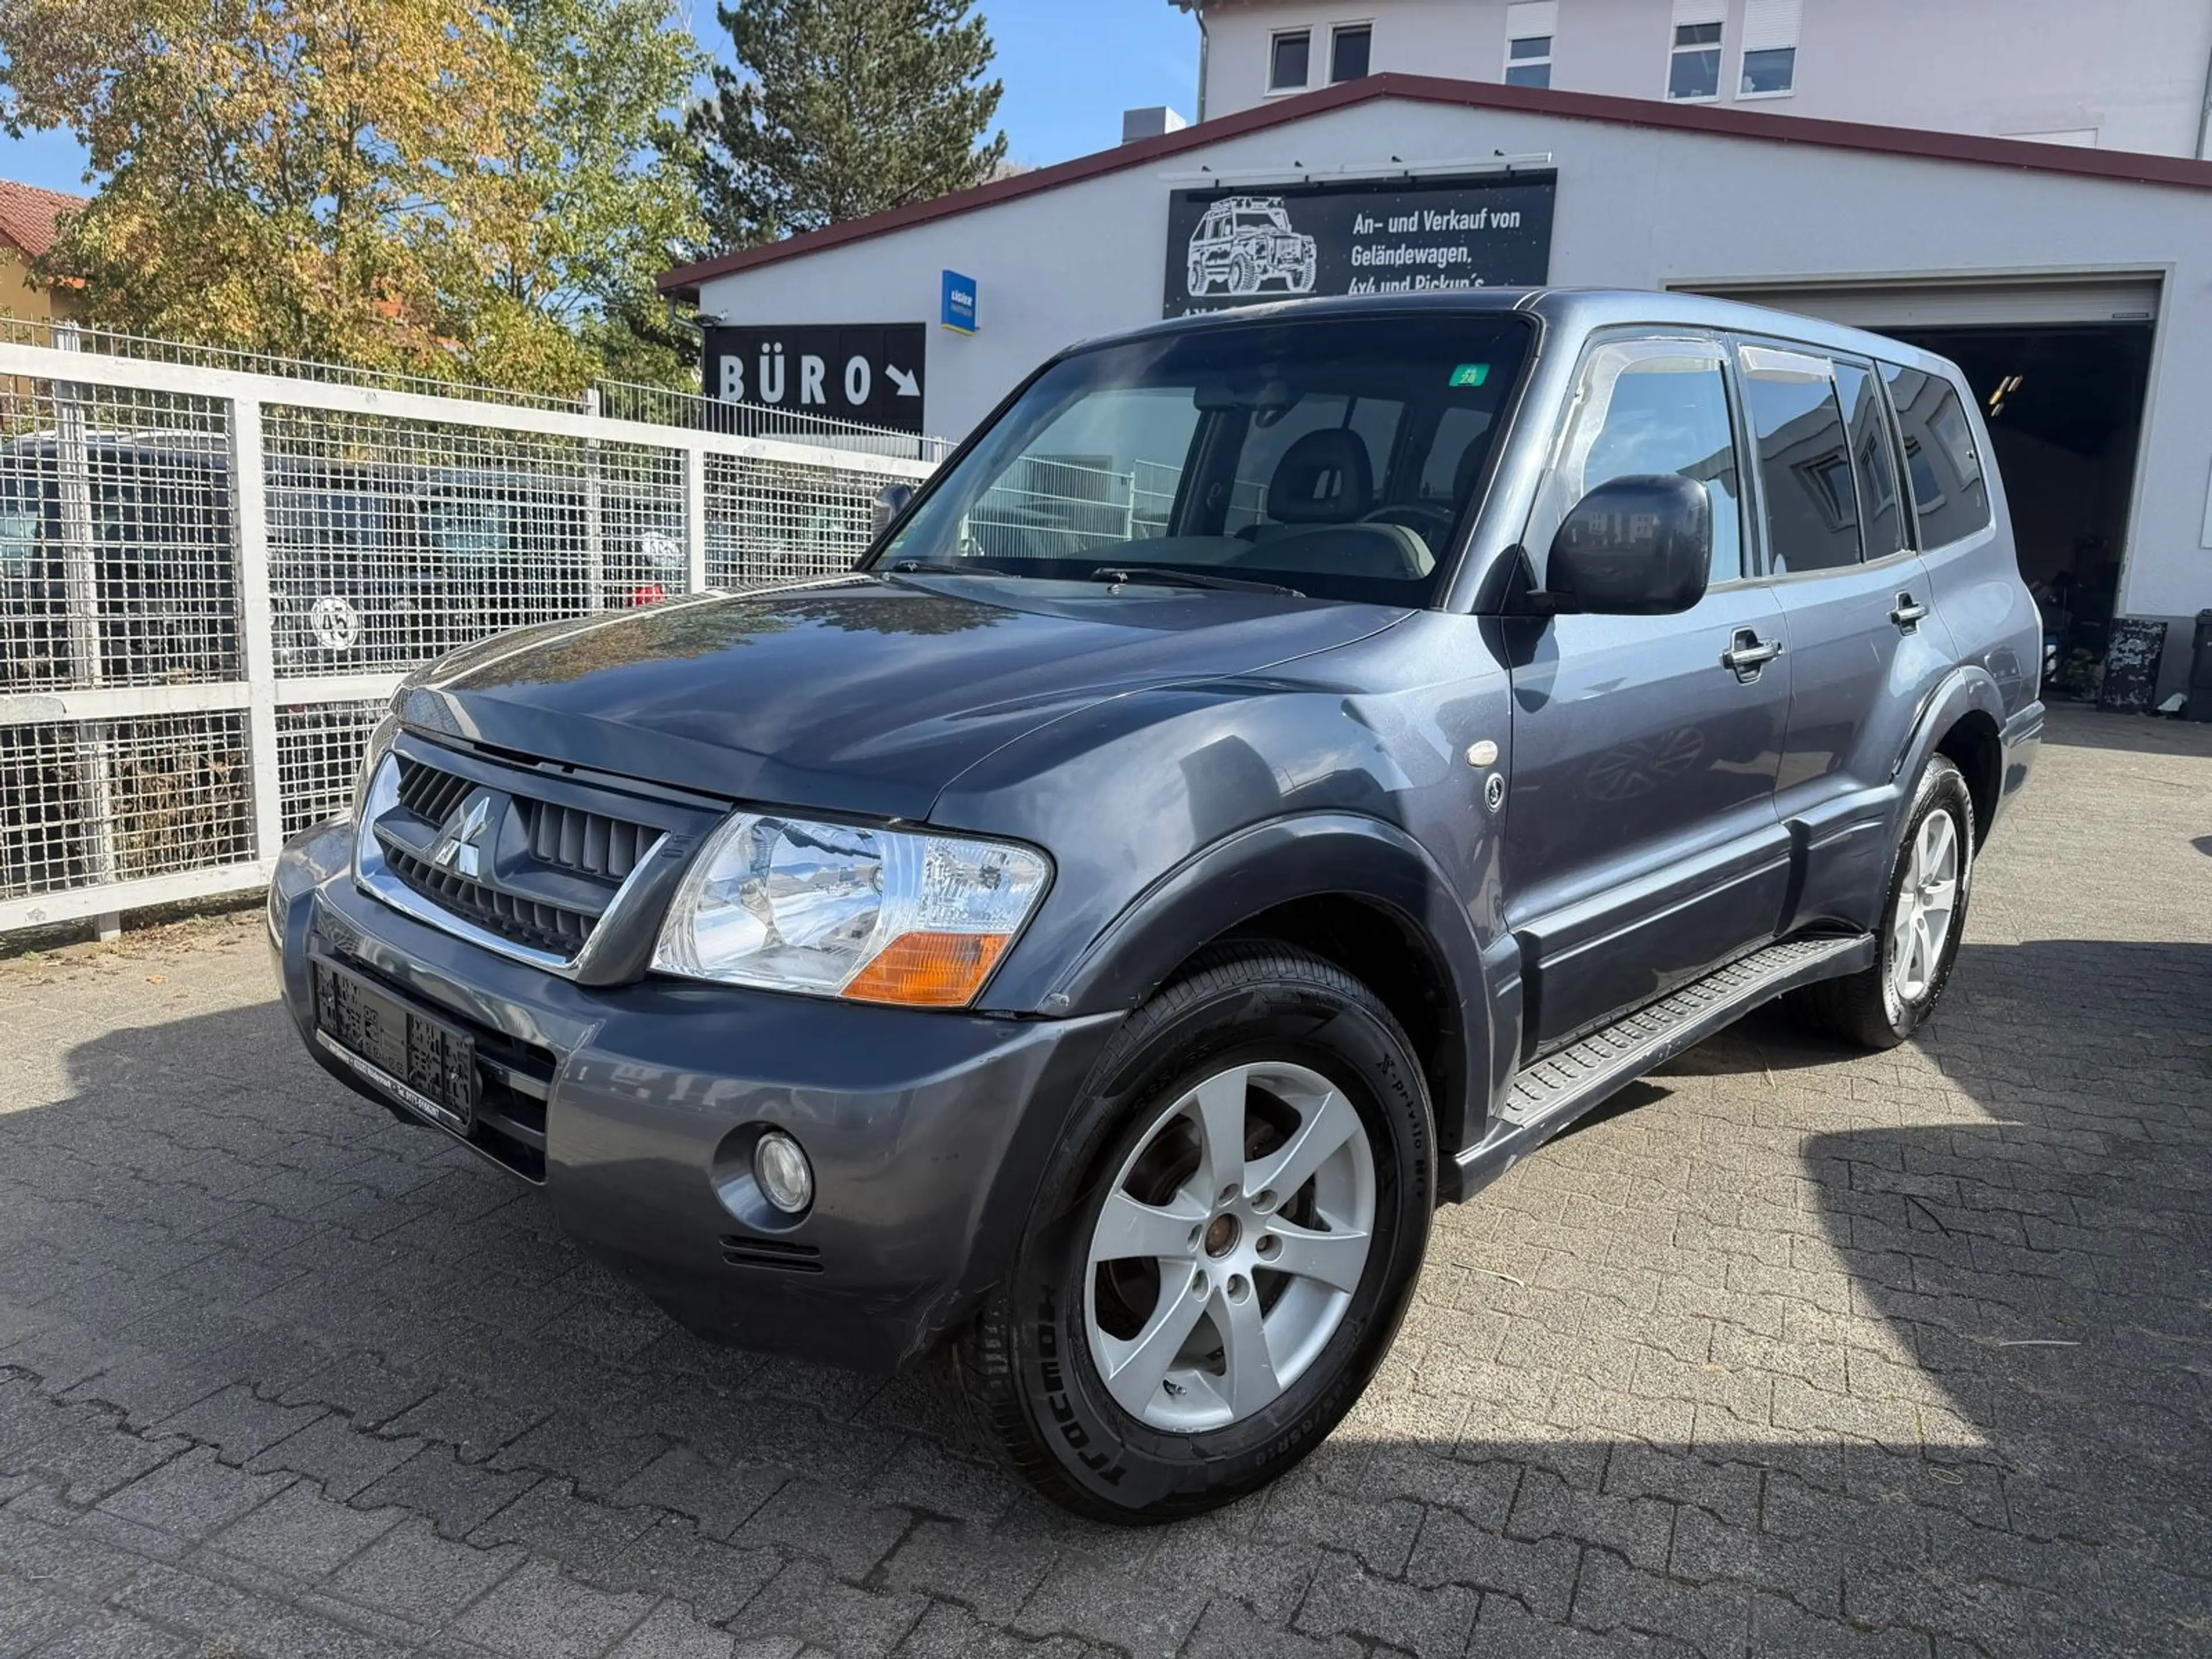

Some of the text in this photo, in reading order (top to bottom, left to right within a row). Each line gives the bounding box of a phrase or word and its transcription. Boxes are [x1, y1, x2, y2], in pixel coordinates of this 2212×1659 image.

[1353, 207, 1521, 234] An- und Verkauf von
[1351, 243, 1472, 268] Geländewagen,
[1348, 276, 1375, 295] 4x4
[1381, 275, 1411, 293] und
[719, 343, 871, 406] BÜRO
